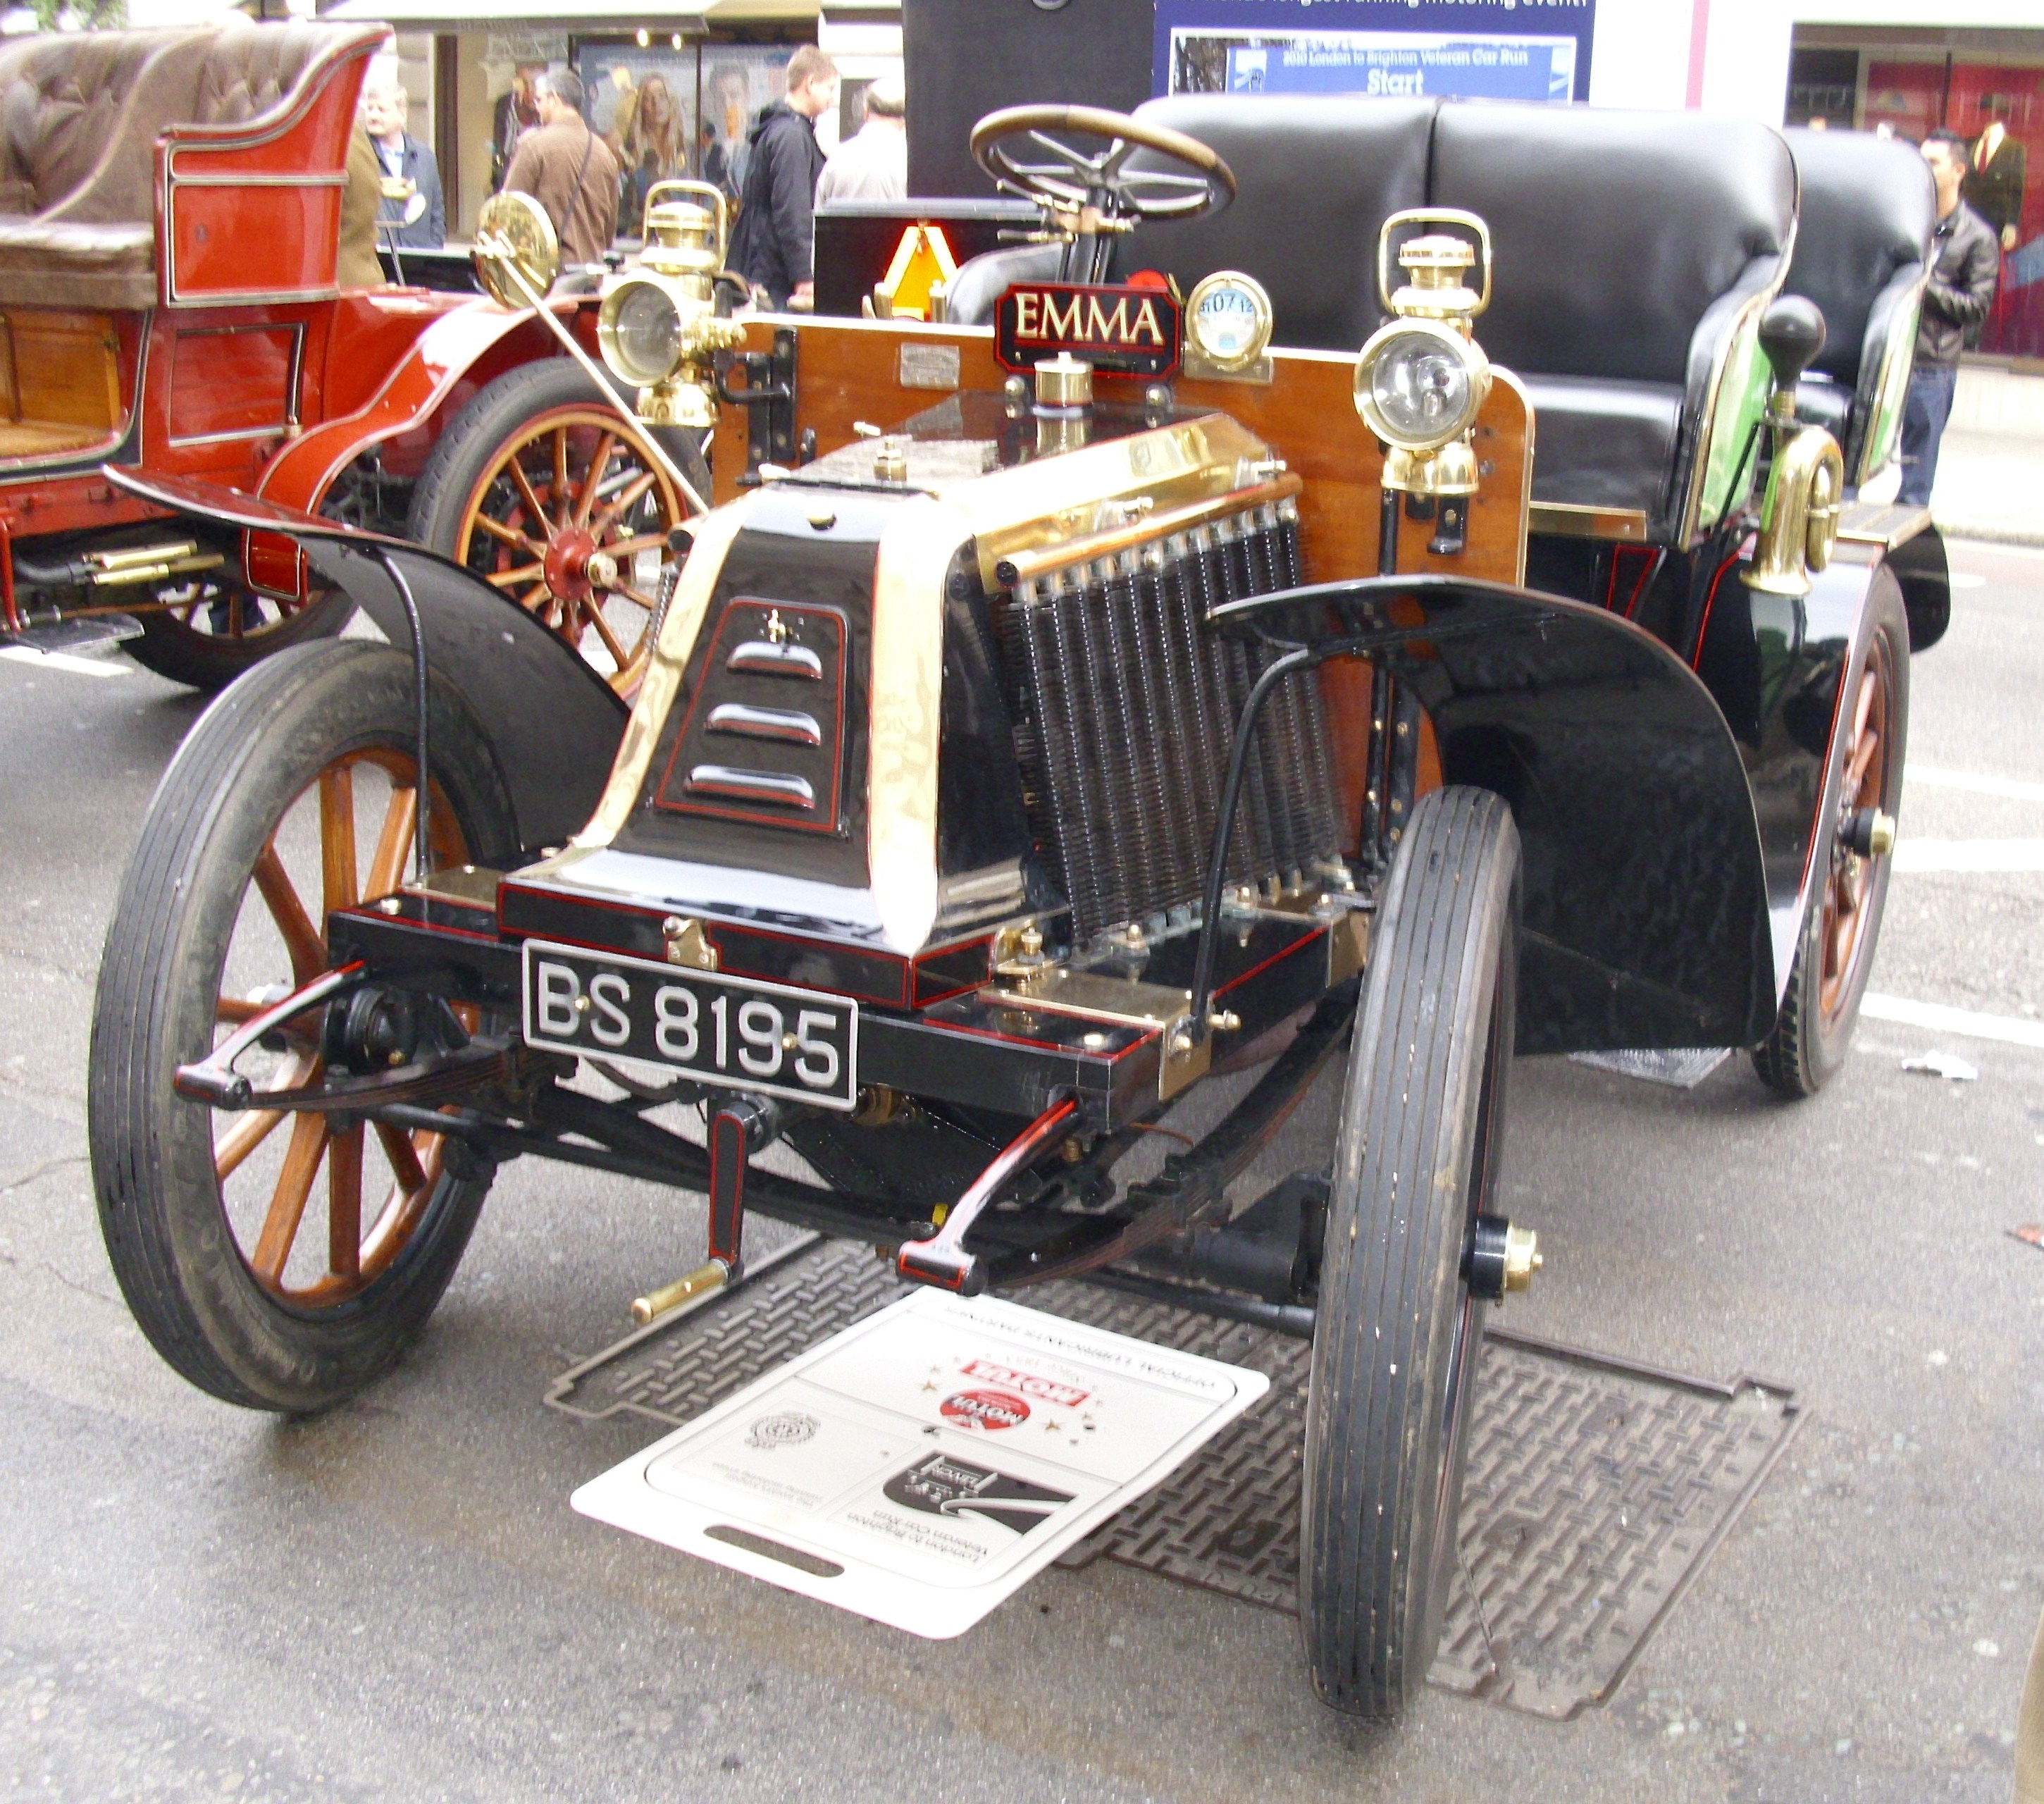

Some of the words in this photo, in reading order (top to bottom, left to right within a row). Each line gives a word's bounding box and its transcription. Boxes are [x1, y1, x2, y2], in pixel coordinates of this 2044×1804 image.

[1309, 50, 1351, 67] London
[1353, 50, 1364, 66] to
[1367, 49, 1417, 68] Brighton
[1420, 49, 1470, 66] Veteran
[1472, 48, 1498, 66] Car
[1500, 48, 1528, 66] Run
[1368, 68, 1423, 95] Start
[1213, 292, 1236, 312] 07
[1015, 292, 1166, 346] EMMA
[538, 960, 631, 1047] BS
[654, 985, 840, 1089] 8195
[970, 1363, 1083, 1405] MOTUL
[951, 1395, 1024, 1425] MOTUL
[848, 1512, 906, 1541] Brighton
[924, 1538, 980, 1566] London
[934, 1530, 989, 1556] Veteran
